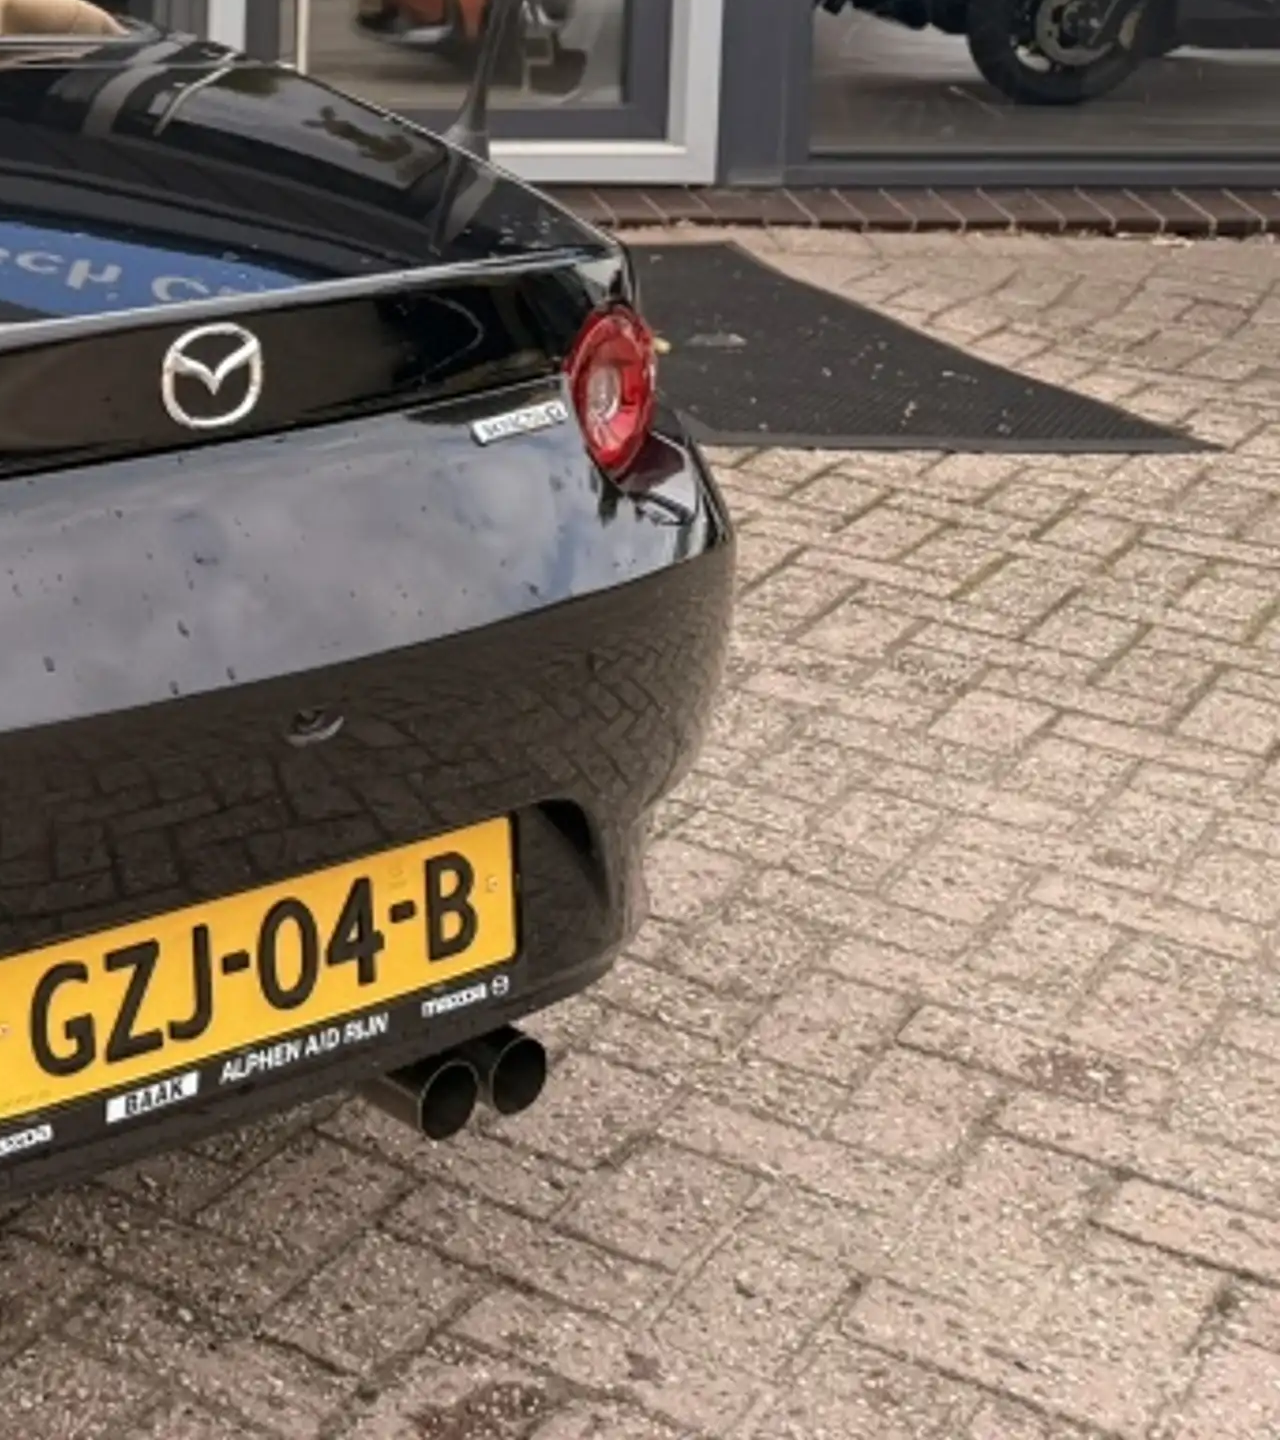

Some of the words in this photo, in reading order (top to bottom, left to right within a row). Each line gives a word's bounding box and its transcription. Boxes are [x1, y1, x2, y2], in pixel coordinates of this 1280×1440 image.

[28, 850, 480, 1077] GZJ-04-B
[219, 1037, 303, 1085] ALPHEN
[343, 1012, 390, 1046] RIJN
[125, 1079, 184, 1115] BAAK
